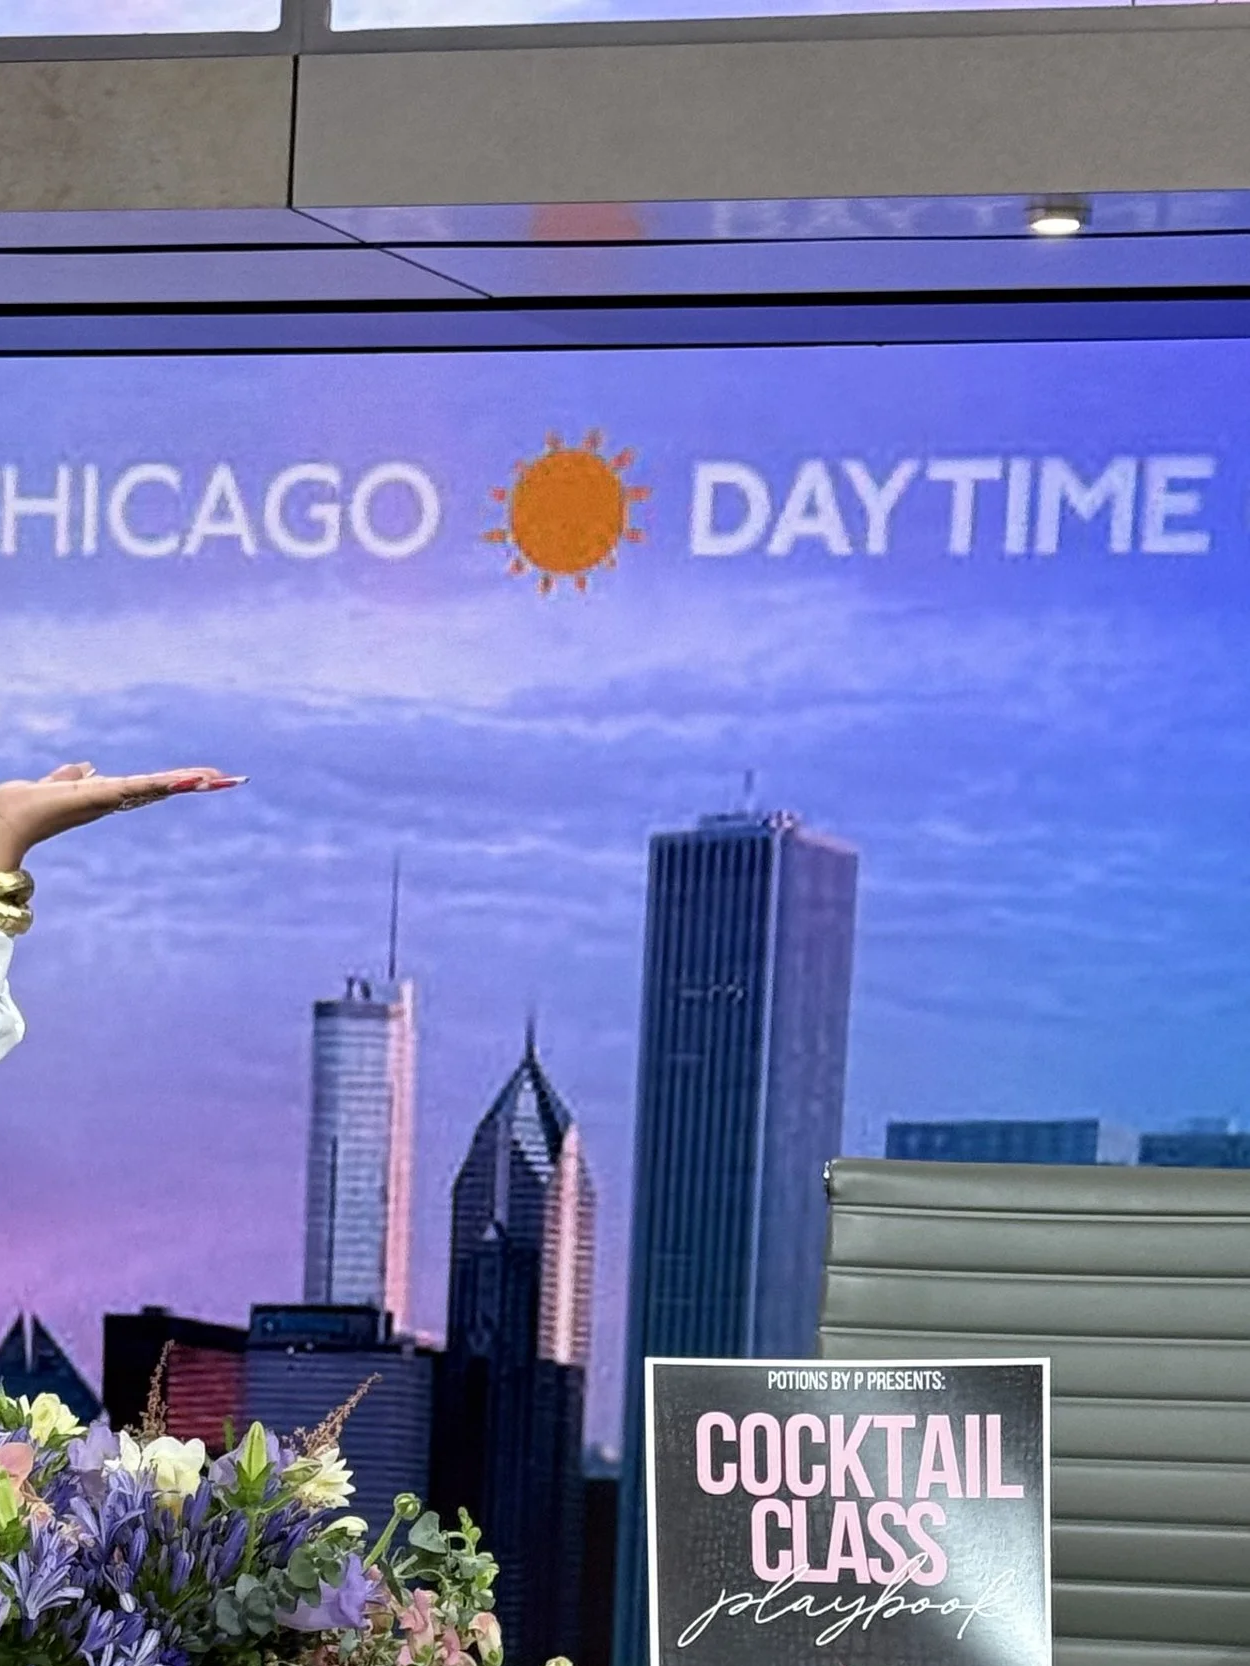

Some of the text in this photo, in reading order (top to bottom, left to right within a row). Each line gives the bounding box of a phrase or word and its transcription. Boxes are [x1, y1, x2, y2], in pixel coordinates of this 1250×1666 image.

[688, 456, 1217, 557] DAYTIME
[767, 1370, 946, 1391] POTIONS BY P PRESENTS:
[695, 1411, 1025, 1499] COCKTAIL
[750, 1498, 948, 1586] CLASS
[677, 1552, 1020, 1648] playbook
